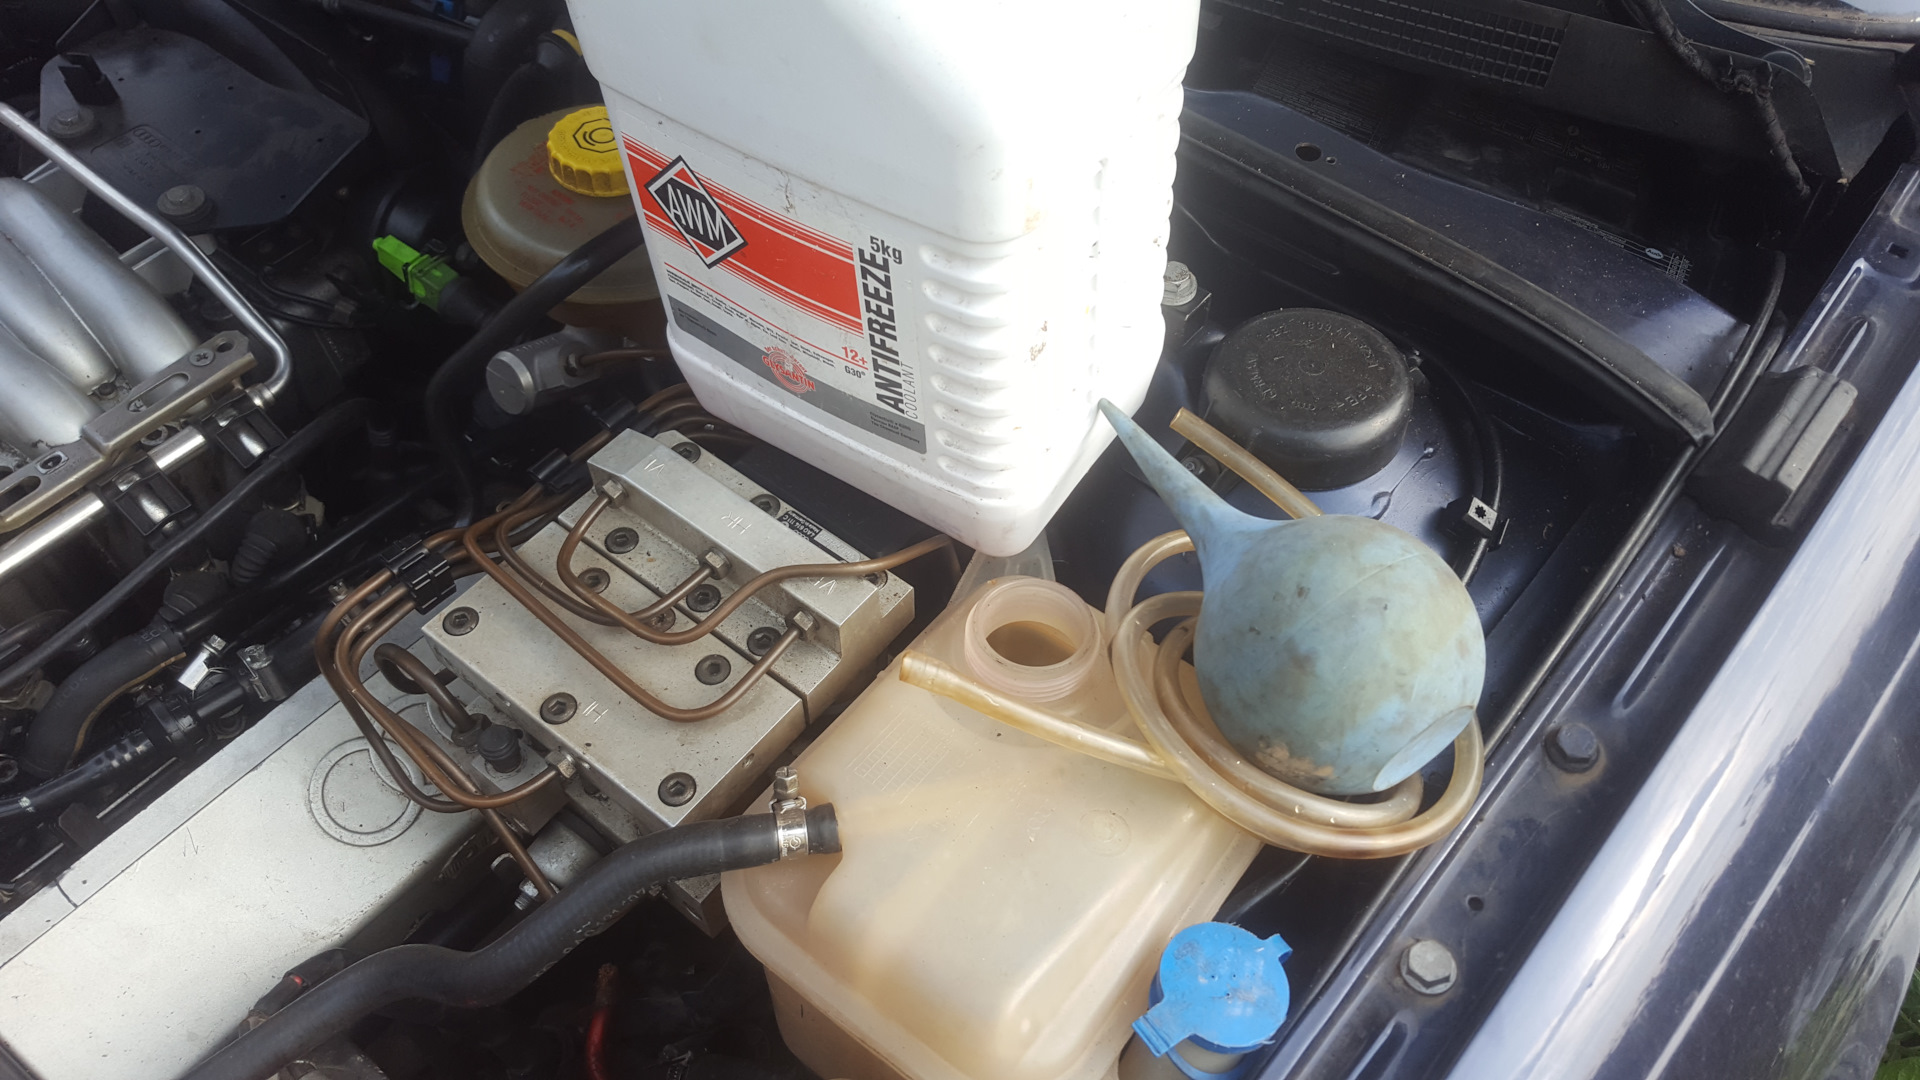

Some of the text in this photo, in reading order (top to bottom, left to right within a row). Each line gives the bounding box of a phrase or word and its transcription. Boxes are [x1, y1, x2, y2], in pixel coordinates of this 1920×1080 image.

[667, 183, 728, 249] AWM
[870, 235, 903, 265] 5kg
[858, 247, 905, 415] ANTIFREEZE
[762, 355, 816, 391] GLYSANTIN
[841, 346, 868, 365] 12+
[901, 361, 918, 419] COOLANT
